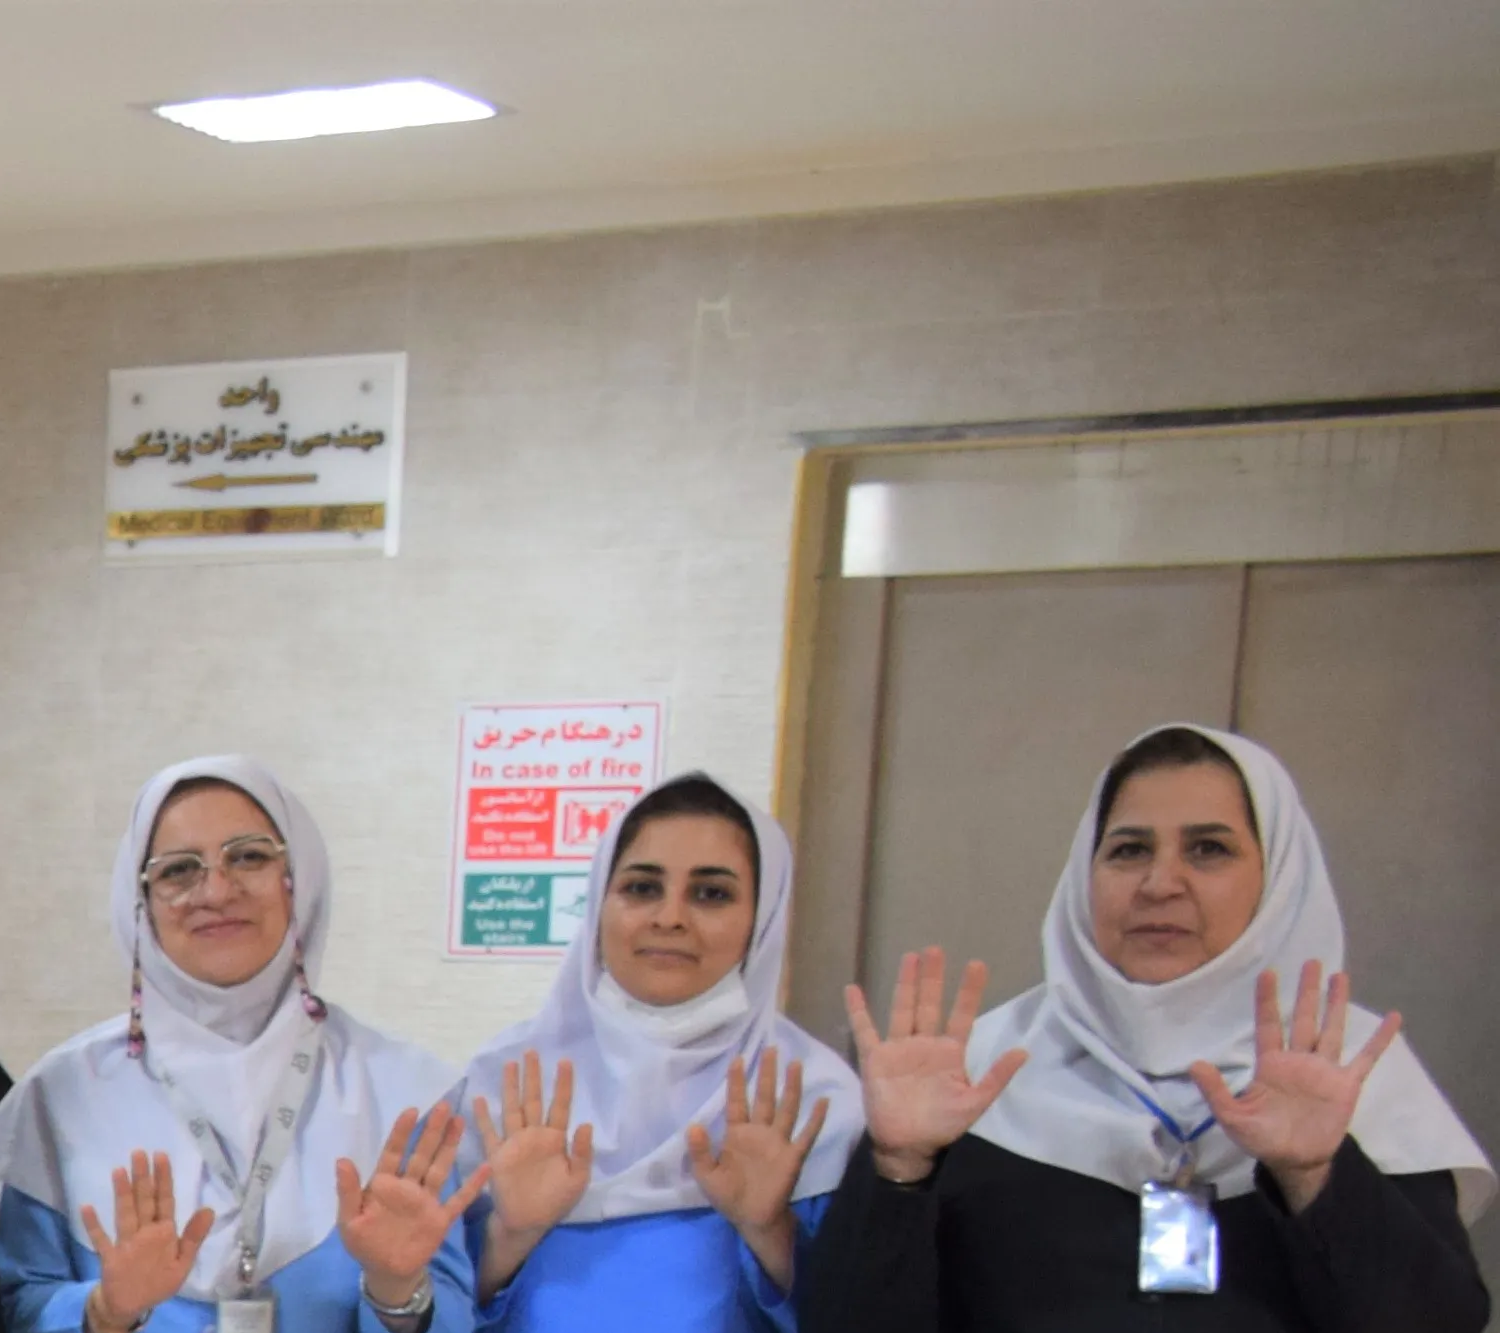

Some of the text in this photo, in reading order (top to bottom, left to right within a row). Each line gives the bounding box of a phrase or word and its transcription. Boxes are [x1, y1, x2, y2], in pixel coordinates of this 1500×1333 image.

[219, 376, 281, 415] واحد
[113, 422, 385, 467] مهندسی تجهیزات پزشکی
[473, 724, 537, 750] حریق
[612, 724, 643, 748] در
[471, 758, 643, 780] In case of fire
